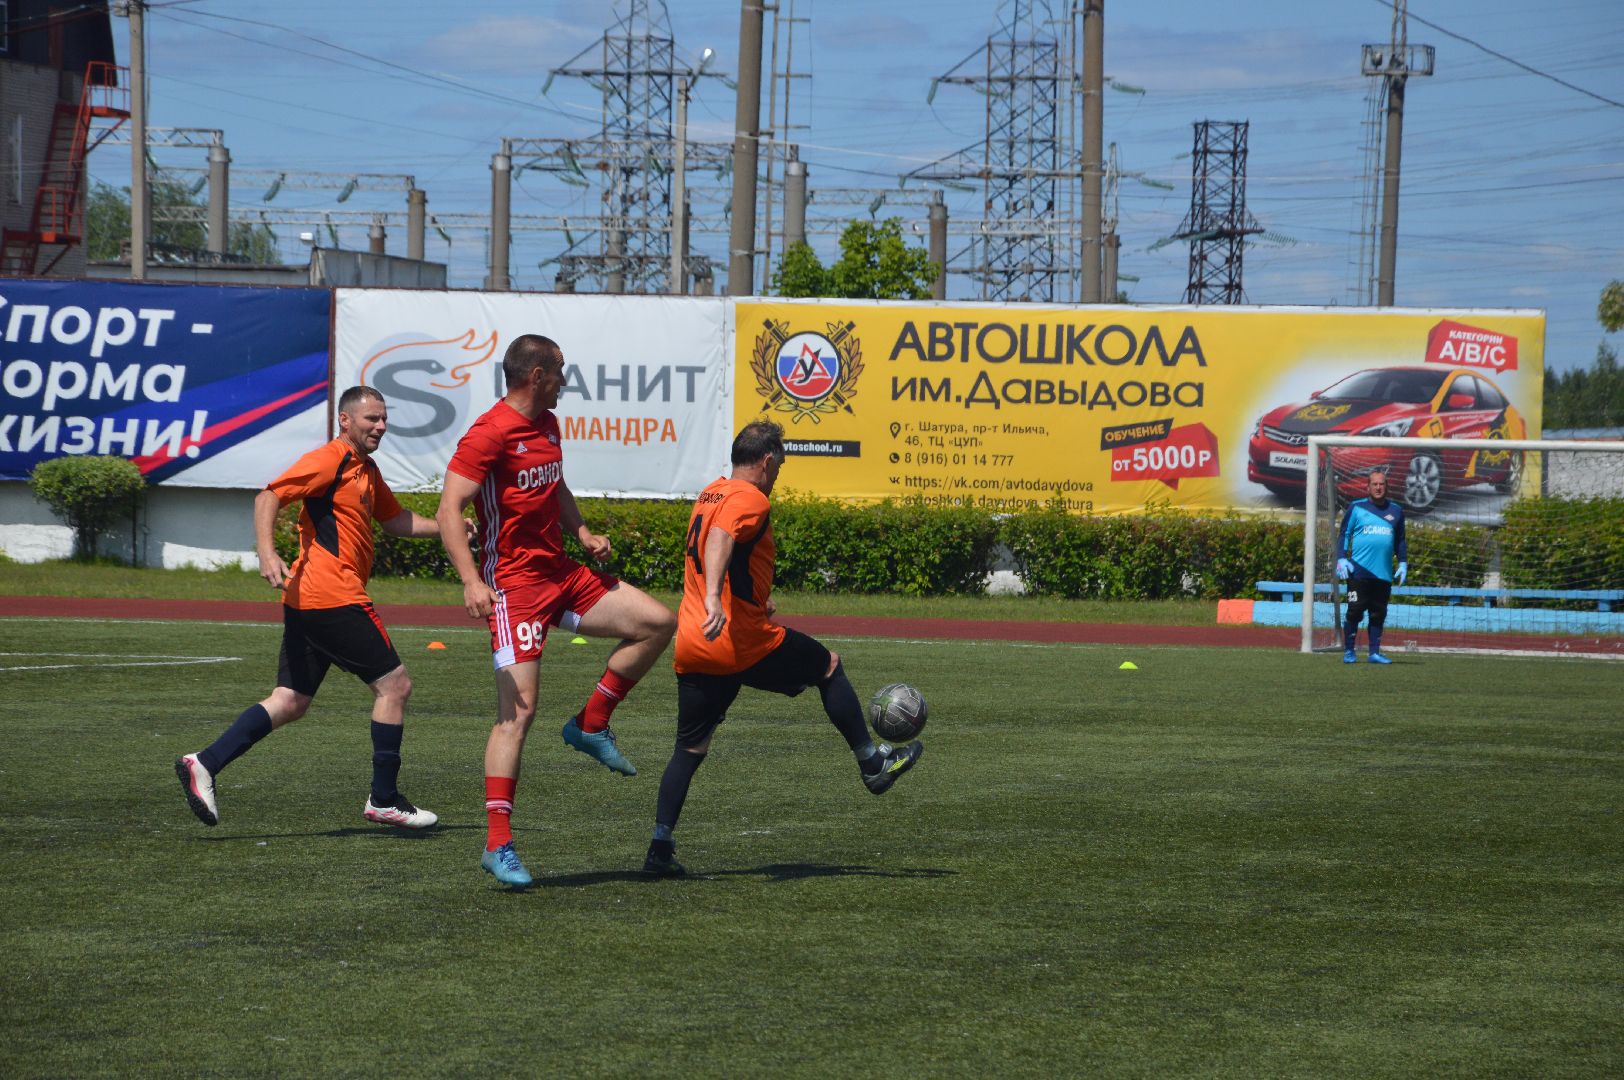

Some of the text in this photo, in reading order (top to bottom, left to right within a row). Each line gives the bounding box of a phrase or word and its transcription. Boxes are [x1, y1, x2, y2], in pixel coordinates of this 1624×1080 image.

[0, 295, 175, 357] порт
[1449, 329, 1504, 345] КАТЕГОРИИ
[888, 321, 1208, 367] АВТОШКОЛА
[0, 359, 187, 411] орма
[494, 361, 707, 403] АНИТ
[557, 416, 677, 446] МАНДРА
[904, 421, 1050, 436] г. Шатура, пр-т Ильича,
[1104, 424, 1166, 442] ОБУЧЕНИЕ
[782, 441, 843, 453] vtoschool.ru
[904, 435, 983, 448] 46, ТЦ «ЦУП»
[904, 452, 1015, 466] 8 (916) 01 14 777
[1132, 445, 1196, 471] 5000
[905, 475, 1094, 494] https://vk.com/avtodavydova
[516, 620, 543, 651] 99
